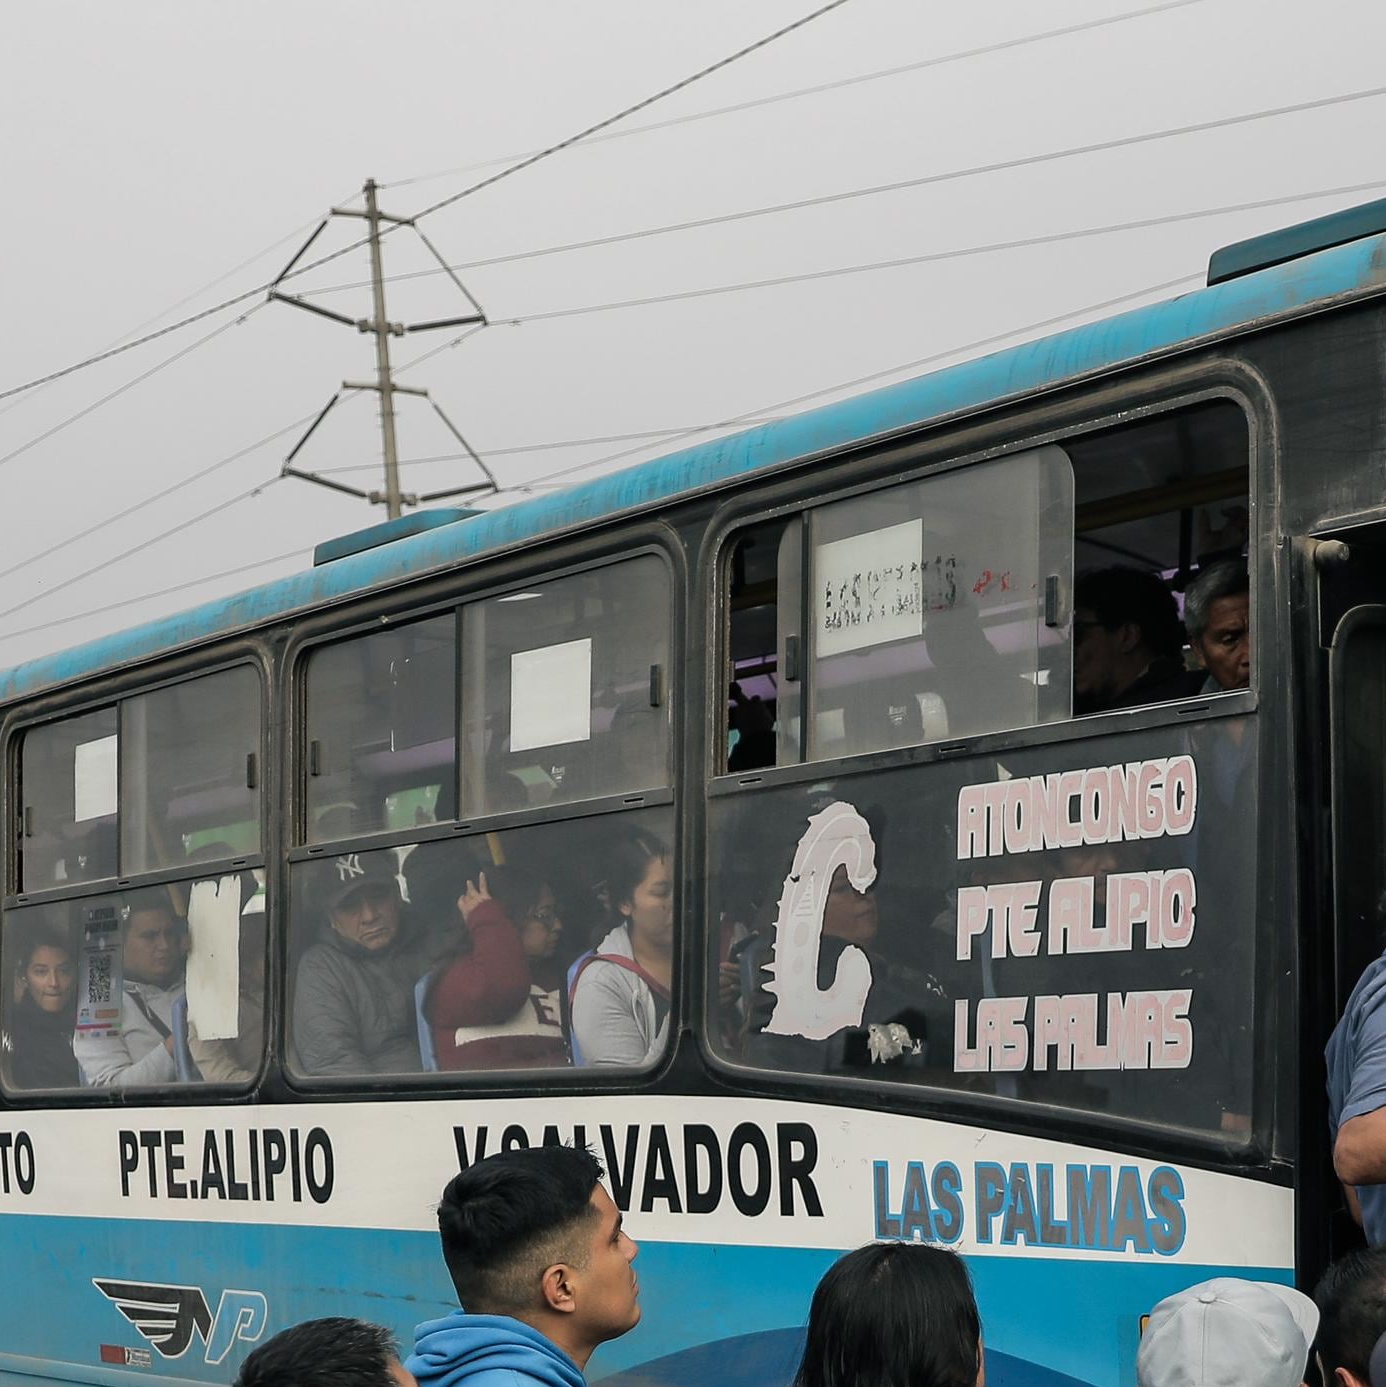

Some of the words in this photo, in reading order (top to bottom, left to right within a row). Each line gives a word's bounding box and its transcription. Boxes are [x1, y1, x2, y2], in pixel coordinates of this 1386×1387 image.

[956, 880, 1043, 960] PTE
[1048, 868, 1197, 956] ALIPIO
[953, 996, 1029, 1073] LAS
[1033, 989, 1193, 1072] PALMAS
[118, 1126, 335, 1204] PTE.ALIPIO
[873, 1160, 964, 1245] LAS
[974, 1161, 1187, 1257] PALMAS
